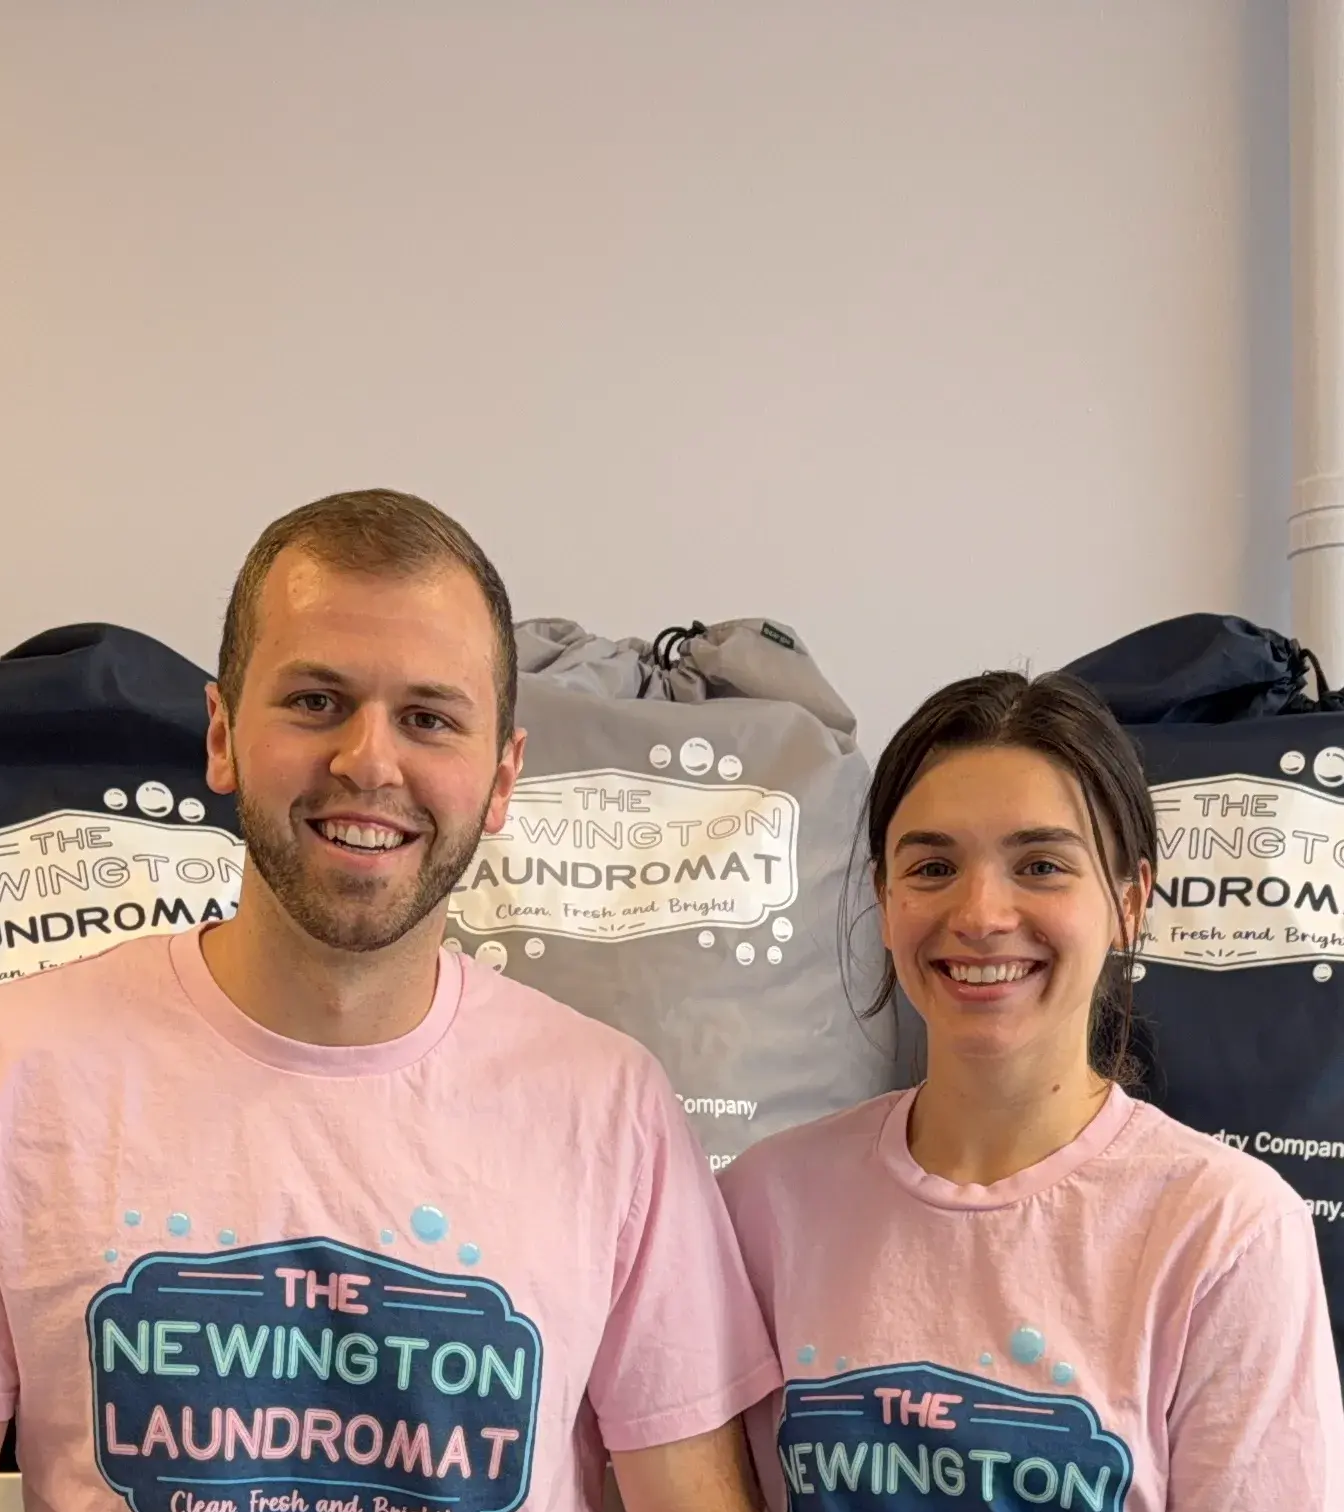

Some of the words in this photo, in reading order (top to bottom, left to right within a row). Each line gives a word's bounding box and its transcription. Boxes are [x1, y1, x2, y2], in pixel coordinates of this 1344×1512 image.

[573, 788, 650, 812] THE
[1194, 793, 1278, 817] THE
[30, 826, 113, 855] THE
[480, 808, 780, 849] WINGTON
[452, 852, 781, 892] AUNDROMAT
[564, 903, 615, 918] Fresh
[622, 901, 660, 916] and
[668, 898, 734, 916] Bright!
[1170, 926, 1226, 940] Fresh
[1233, 928, 1274, 940] and
[675, 1094, 757, 1120] ompany
[275, 1268, 370, 1315] THE
[103, 1318, 525, 1400] NEWINGTON
[874, 1388, 962, 1430] THE
[106, 1402, 520, 1480] LAUNDROMAT
